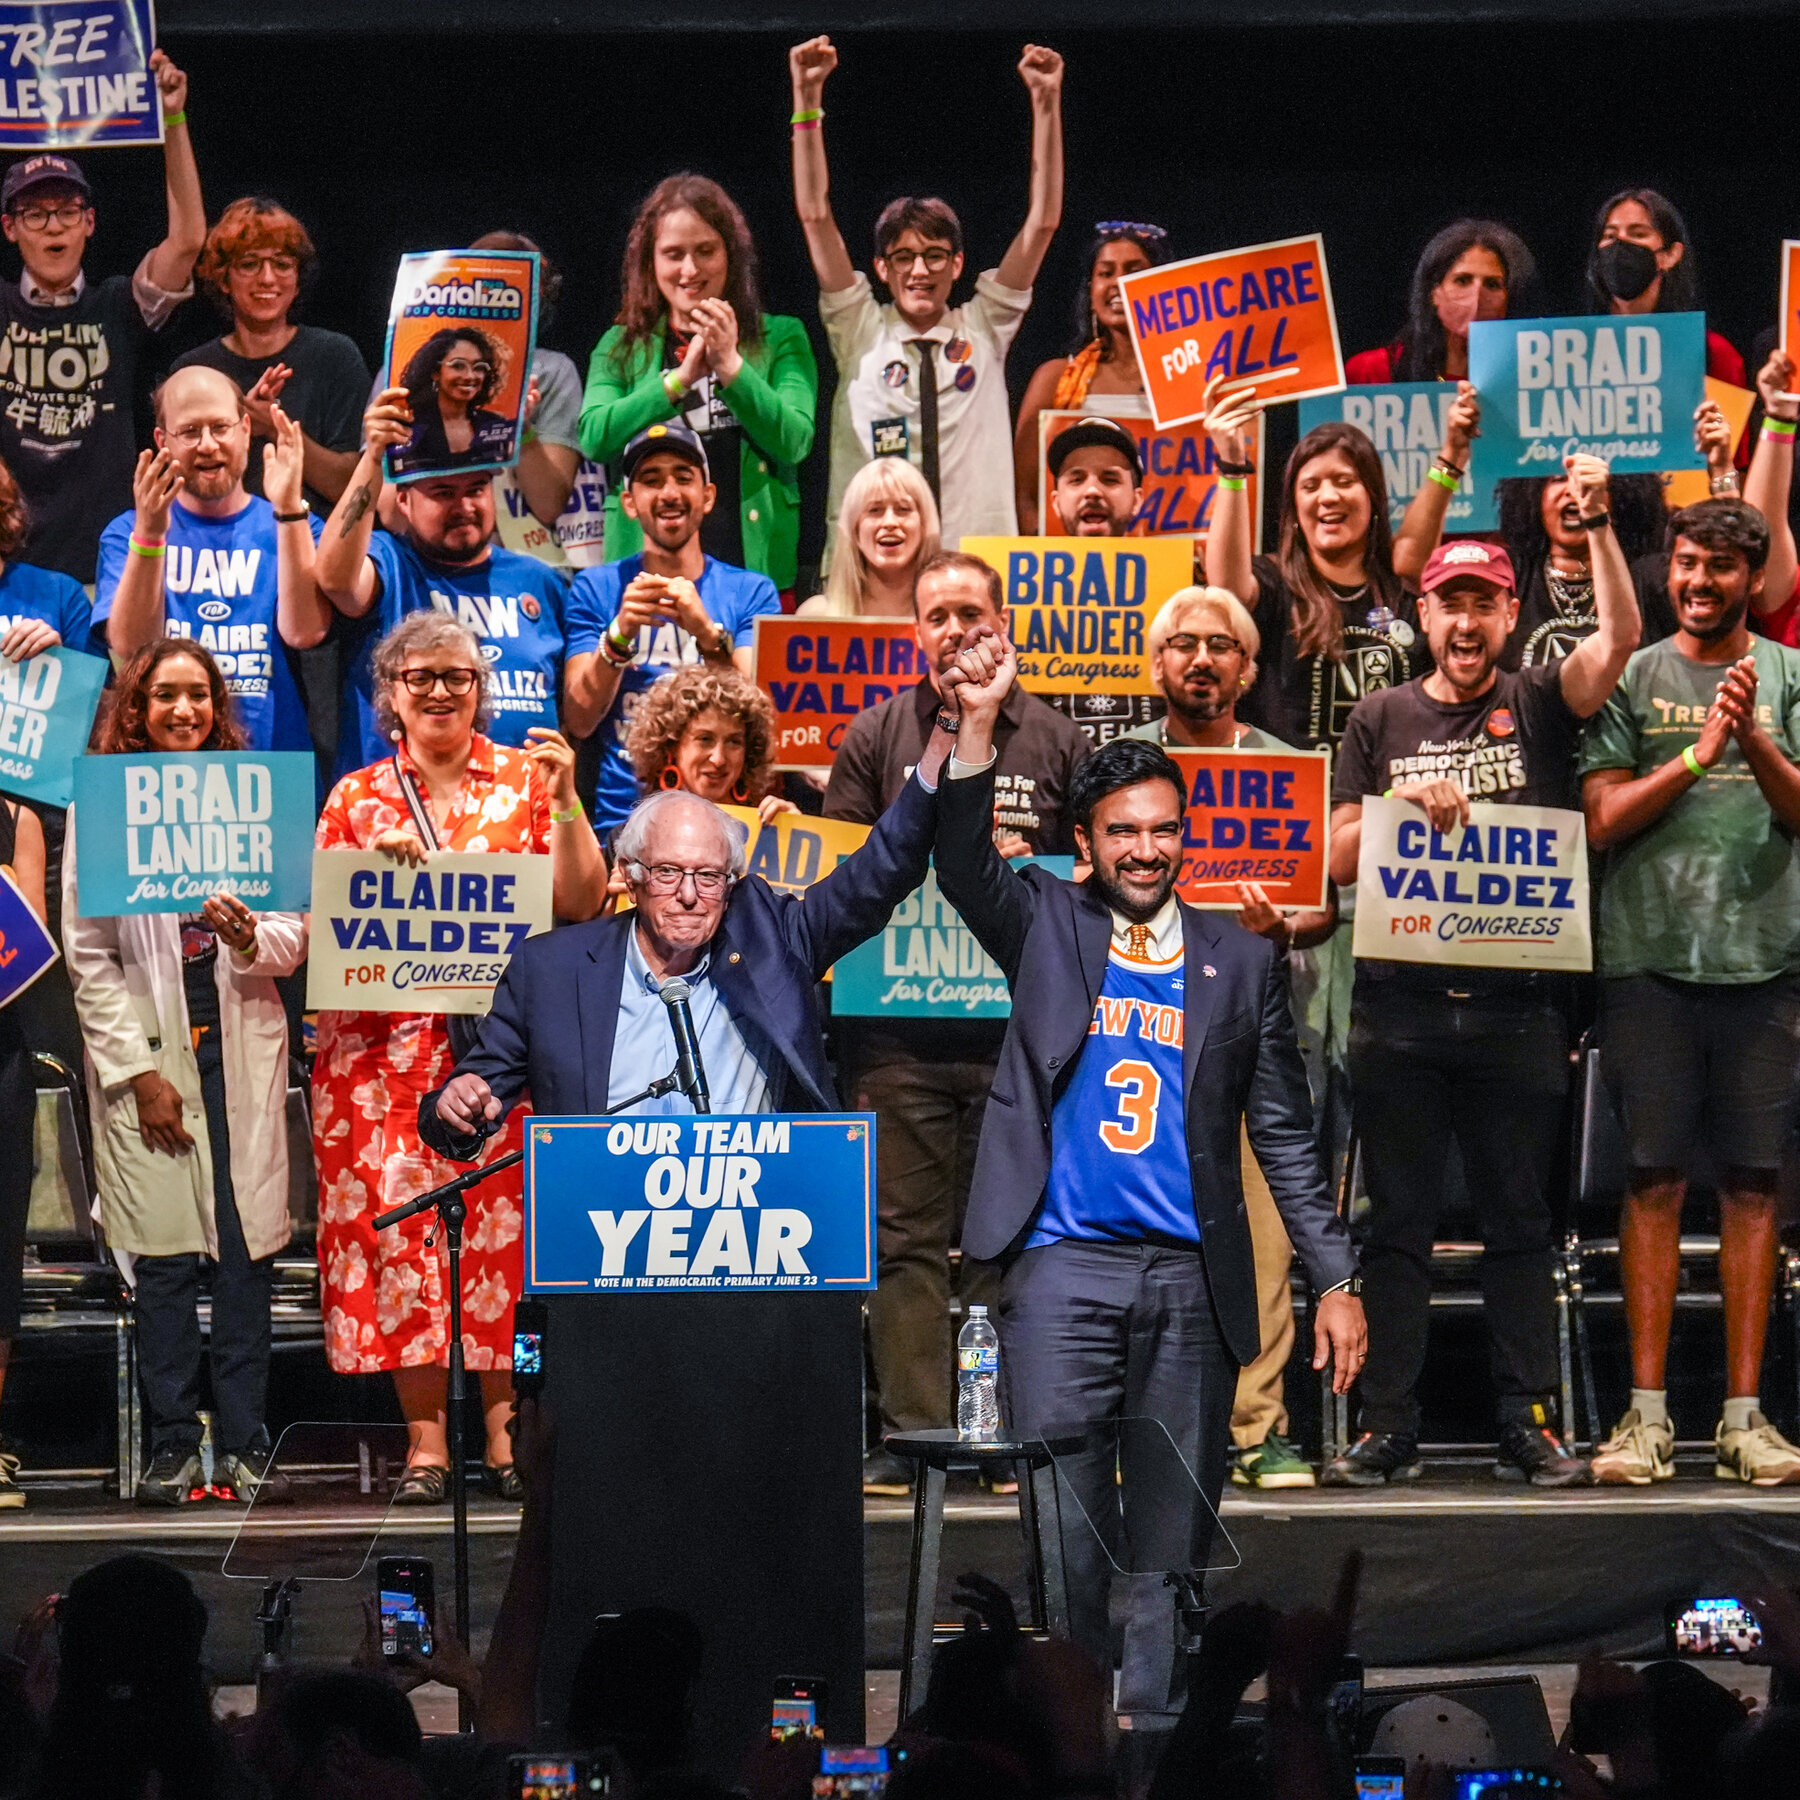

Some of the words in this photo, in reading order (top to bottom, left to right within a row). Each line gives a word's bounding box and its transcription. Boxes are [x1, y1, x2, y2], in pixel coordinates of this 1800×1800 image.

[0, 72, 150, 118] LESTINE
[404, 306, 431, 316] FOR
[437, 306, 520, 318] CONGRESS
[1133, 261, 1319, 339] MEDICARE
[1161, 339, 1201, 381] FOR
[1205, 317, 1298, 382] ALL
[1517, 325, 1662, 389] BRAD
[1518, 385, 1663, 438] LANDER
[1518, 439, 1560, 465] for
[522, 528, 549, 549] FOR
[166, 545, 261, 597] UAW
[1007, 551, 1147, 607] BRAD
[205, 604, 224, 616] FOR
[1008, 608, 1145, 656] LANDER
[0, 652, 63, 711] AD
[214, 653, 273, 677] DEZ
[1045, 656, 1142, 685] Congress
[781, 725, 821, 749] FOR
[124, 764, 273, 826] BRAD
[1014, 774, 1036, 792] For
[1020, 793, 1032, 809] &
[1189, 768, 1295, 810] AIRE
[998, 811, 1041, 829] nomic
[1181, 817, 1313, 852] LDEZ
[126, 823, 273, 876] LANDER
[740, 822, 822, 887] AD
[1397, 820, 1558, 867] CLAIRE
[126, 876, 170, 904] for
[171, 874, 271, 900] Congress
[349, 870, 516, 913] CLAIRE
[1378, 866, 1575, 909] VALDEZ
[330, 917, 532, 955] VALDEZ
[1391, 915, 1432, 935] FOR
[1437, 913, 1563, 941] CONGRESS
[344, 964, 386, 987] FOR
[392, 961, 503, 990] CONGRES
[880, 978, 924, 1005] for
[1099, 1058, 1162, 1155] 3
[607, 1122, 681, 1156] OUR
[692, 1121, 790, 1154] TEAM
[644, 1155, 761, 1209] OUR
[587, 1208, 813, 1276] YEAR
[593, 1277, 620, 1288] VOTE
[621, 1277, 634, 1288] IN
[635, 1277, 655, 1288] THE
[656, 1276, 722, 1288] DEMOCRATIC
[723, 1275, 773, 1287] PRIMARY
[774, 1275, 801, 1286] JUNE
[802, 1275, 818, 1286] 23
